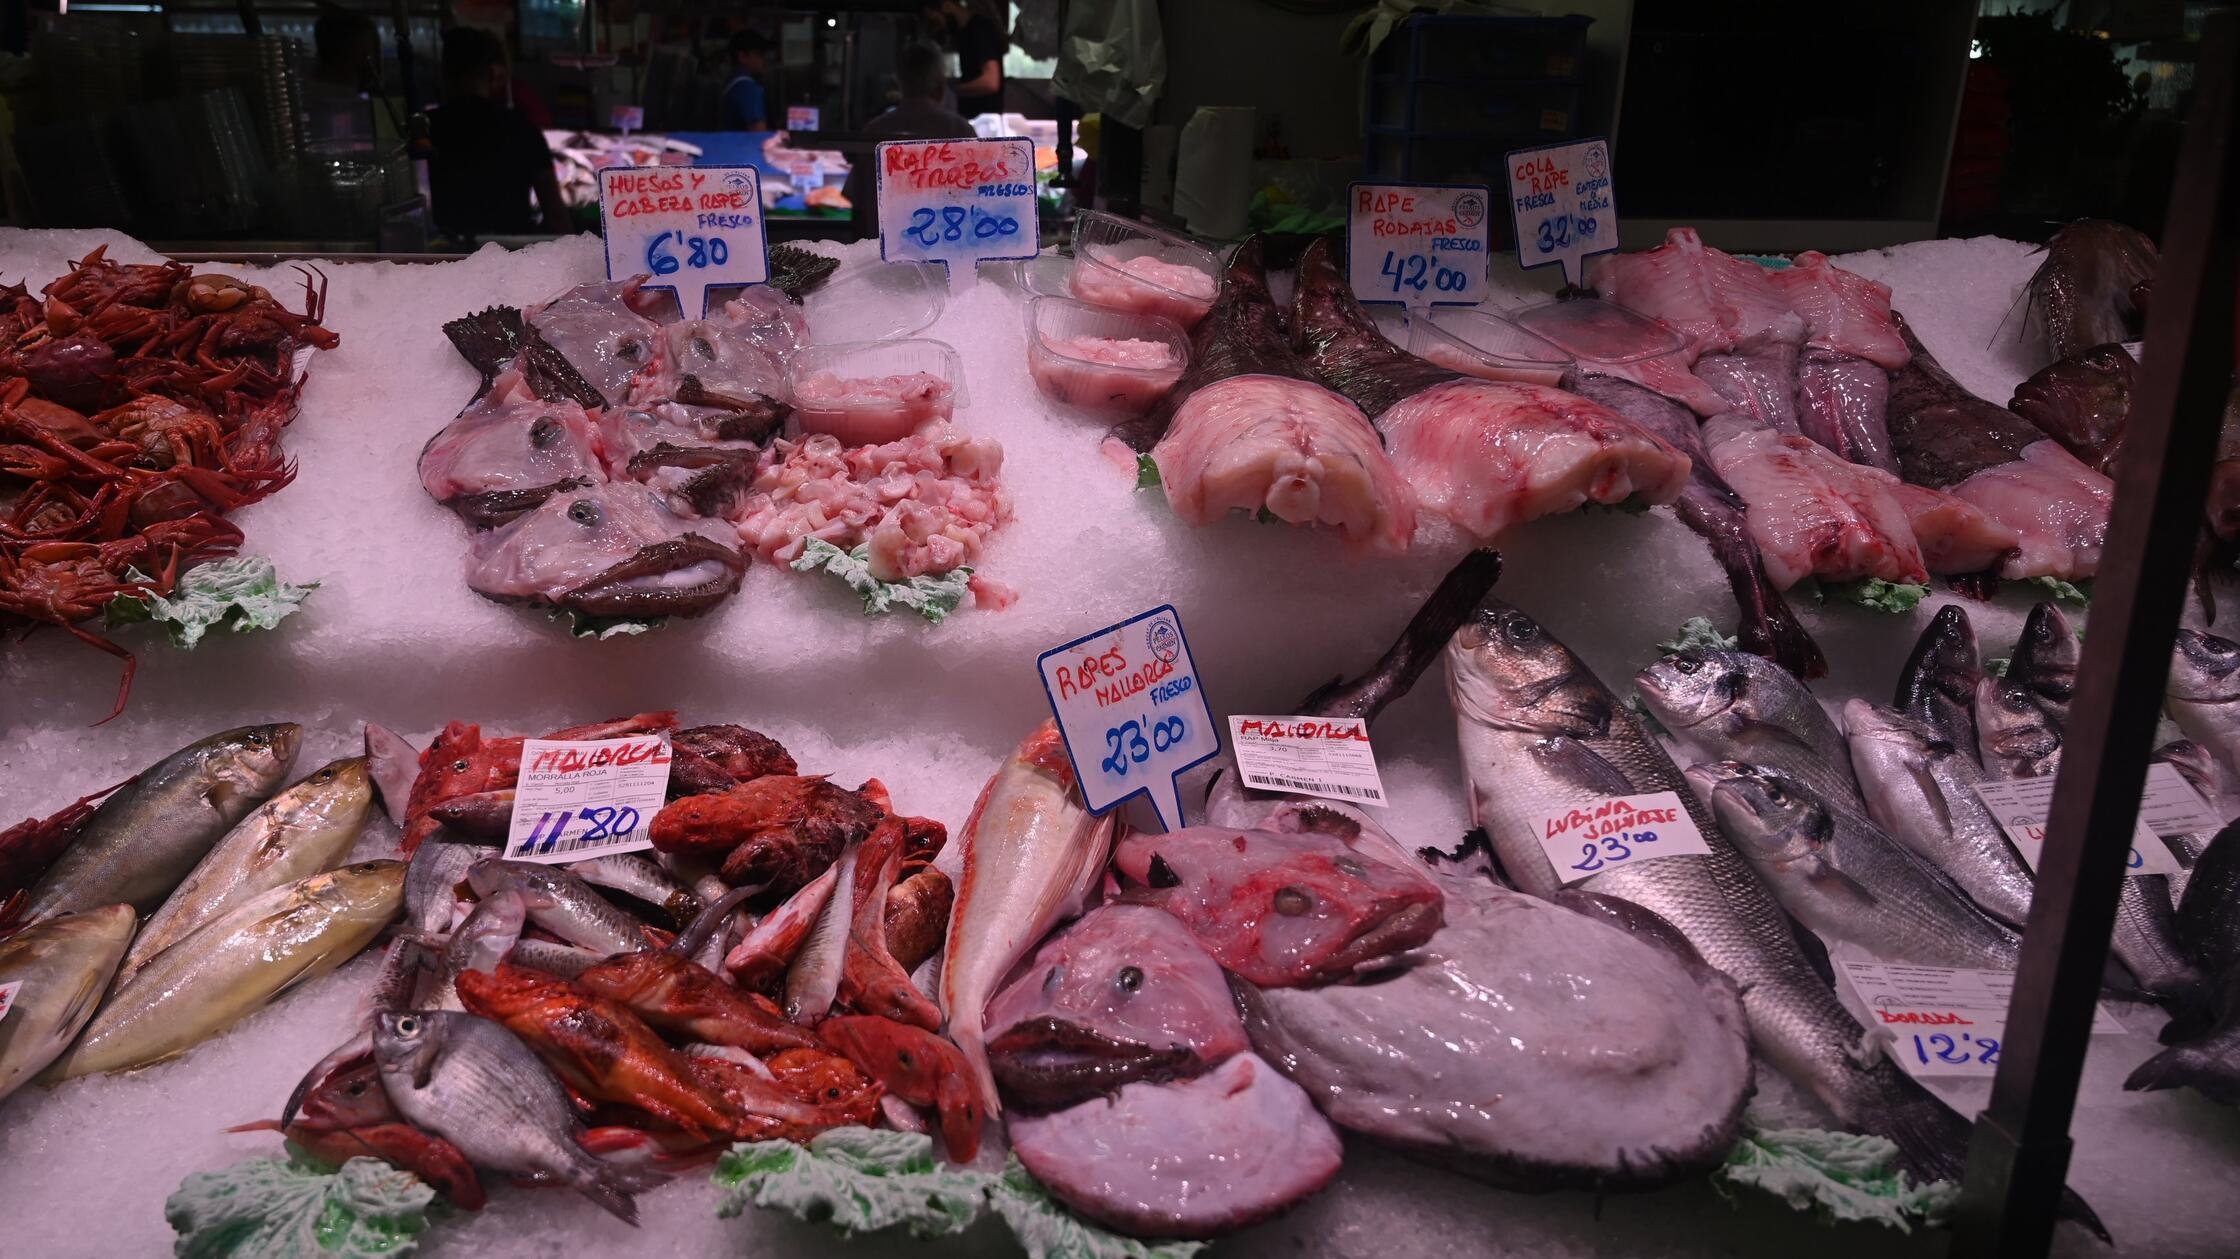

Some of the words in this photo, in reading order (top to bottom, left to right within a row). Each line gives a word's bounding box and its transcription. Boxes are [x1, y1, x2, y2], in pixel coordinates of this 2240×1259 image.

[886, 143, 955, 176] RAPE
[1516, 157, 1555, 180] COLA
[609, 174, 684, 197] HUESOS
[692, 173, 705, 190] Y
[1532, 169, 1569, 194] RAPE
[613, 197, 693, 218] CABEZA
[701, 193, 743, 210] RAPE
[1360, 191, 1415, 213] RAPE
[1516, 192, 1555, 213] FRESCA
[697, 213, 753, 229] FRESCO
[907, 205, 1018, 246] 28'00
[1373, 218, 1456, 237] RODAJAS
[1538, 213, 1597, 253] 32'00
[648, 230, 728, 276] 6'80
[1431, 237, 1481, 252] FRESCO
[1381, 251, 1467, 293] 42'00
[1056, 647, 1127, 700] RAPES
[1096, 658, 1174, 707] MALLORCA
[1150, 676, 1192, 706] FRESCO
[1102, 714, 1184, 776] 23'00
[528, 772, 580, 781] MORRALLA
[583, 768, 607, 778] ROJA
[555, 786, 575, 795] 5,00
[559, 828, 589, 837] ARMEN
[1571, 831, 1658, 871] 23'00
[1914, 1033, 2000, 1065] 12'8
